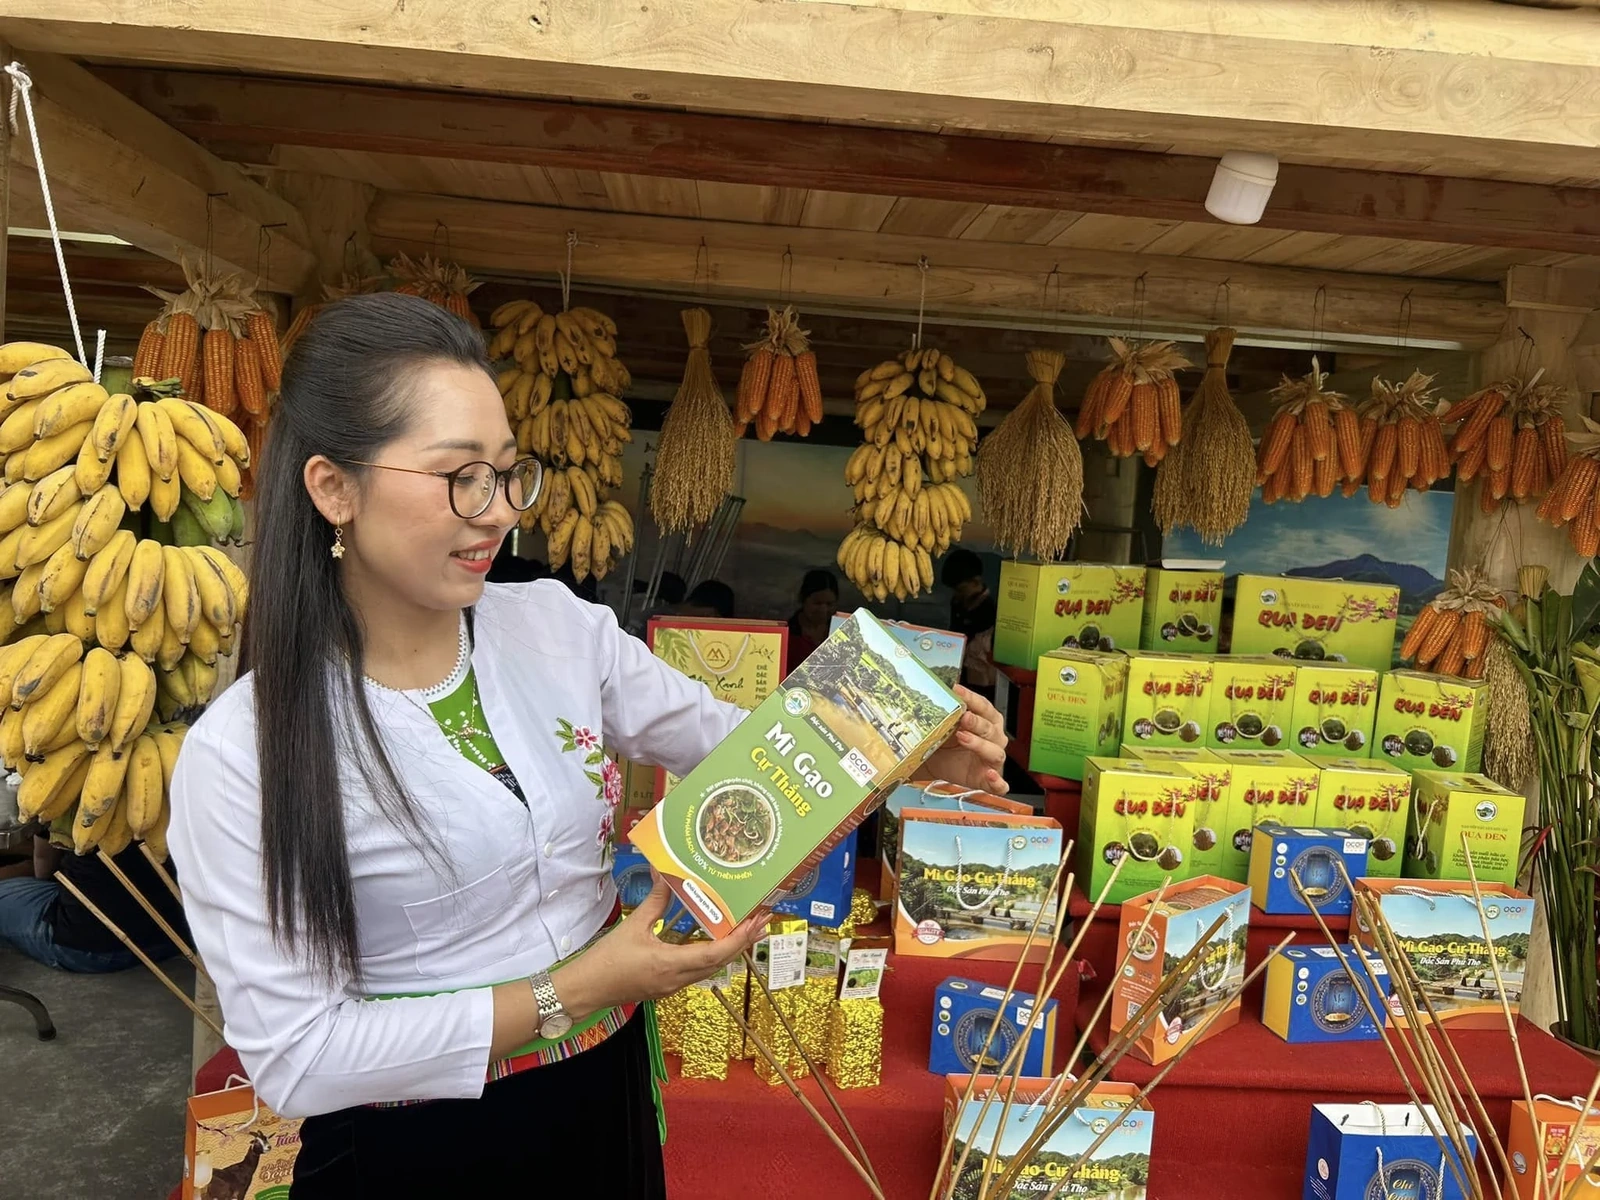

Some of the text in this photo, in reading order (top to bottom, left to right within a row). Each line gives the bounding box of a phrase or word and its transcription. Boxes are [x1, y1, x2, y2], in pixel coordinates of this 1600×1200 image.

[764, 720, 796, 756] Mì
[793, 752, 833, 798] Gạo
[849, 752, 873, 776] OCOP
[750, 747, 812, 818] Cự Thắng
[692, 852, 709, 869] 100%
[924, 868, 940, 880] Mì
[974, 870, 994, 886] Cự
